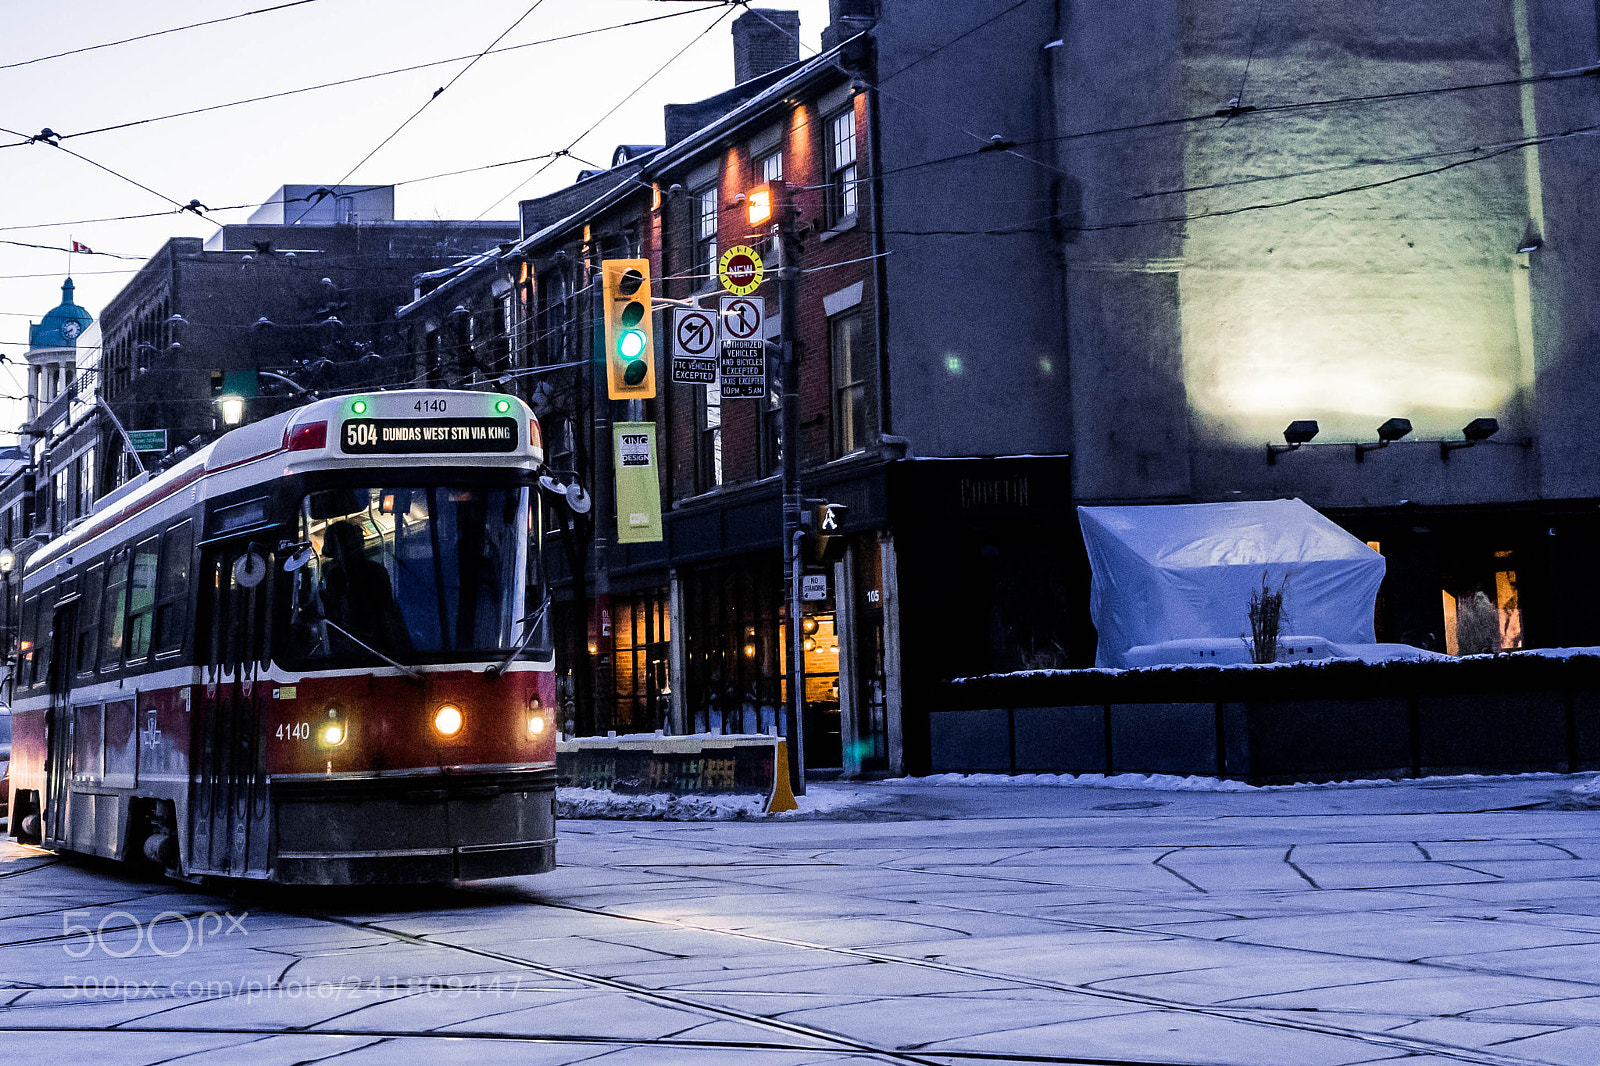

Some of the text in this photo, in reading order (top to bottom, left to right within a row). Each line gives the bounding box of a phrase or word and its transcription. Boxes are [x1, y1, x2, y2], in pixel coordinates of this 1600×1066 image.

[729, 265, 753, 278] NEW
[722, 341, 762, 349] AUTHORIZED
[674, 361, 715, 370] TTC VEHICLES
[676, 371, 713, 380] EXCEPTED
[726, 367, 759, 375] EXCEPTED
[414, 400, 447, 412] 4140
[347, 424, 511, 445] 504 DUNDAS WEST STN VIA KING
[622, 436, 649, 444] KING
[867, 590, 880, 602] 105
[275, 722, 310, 740] 4140
